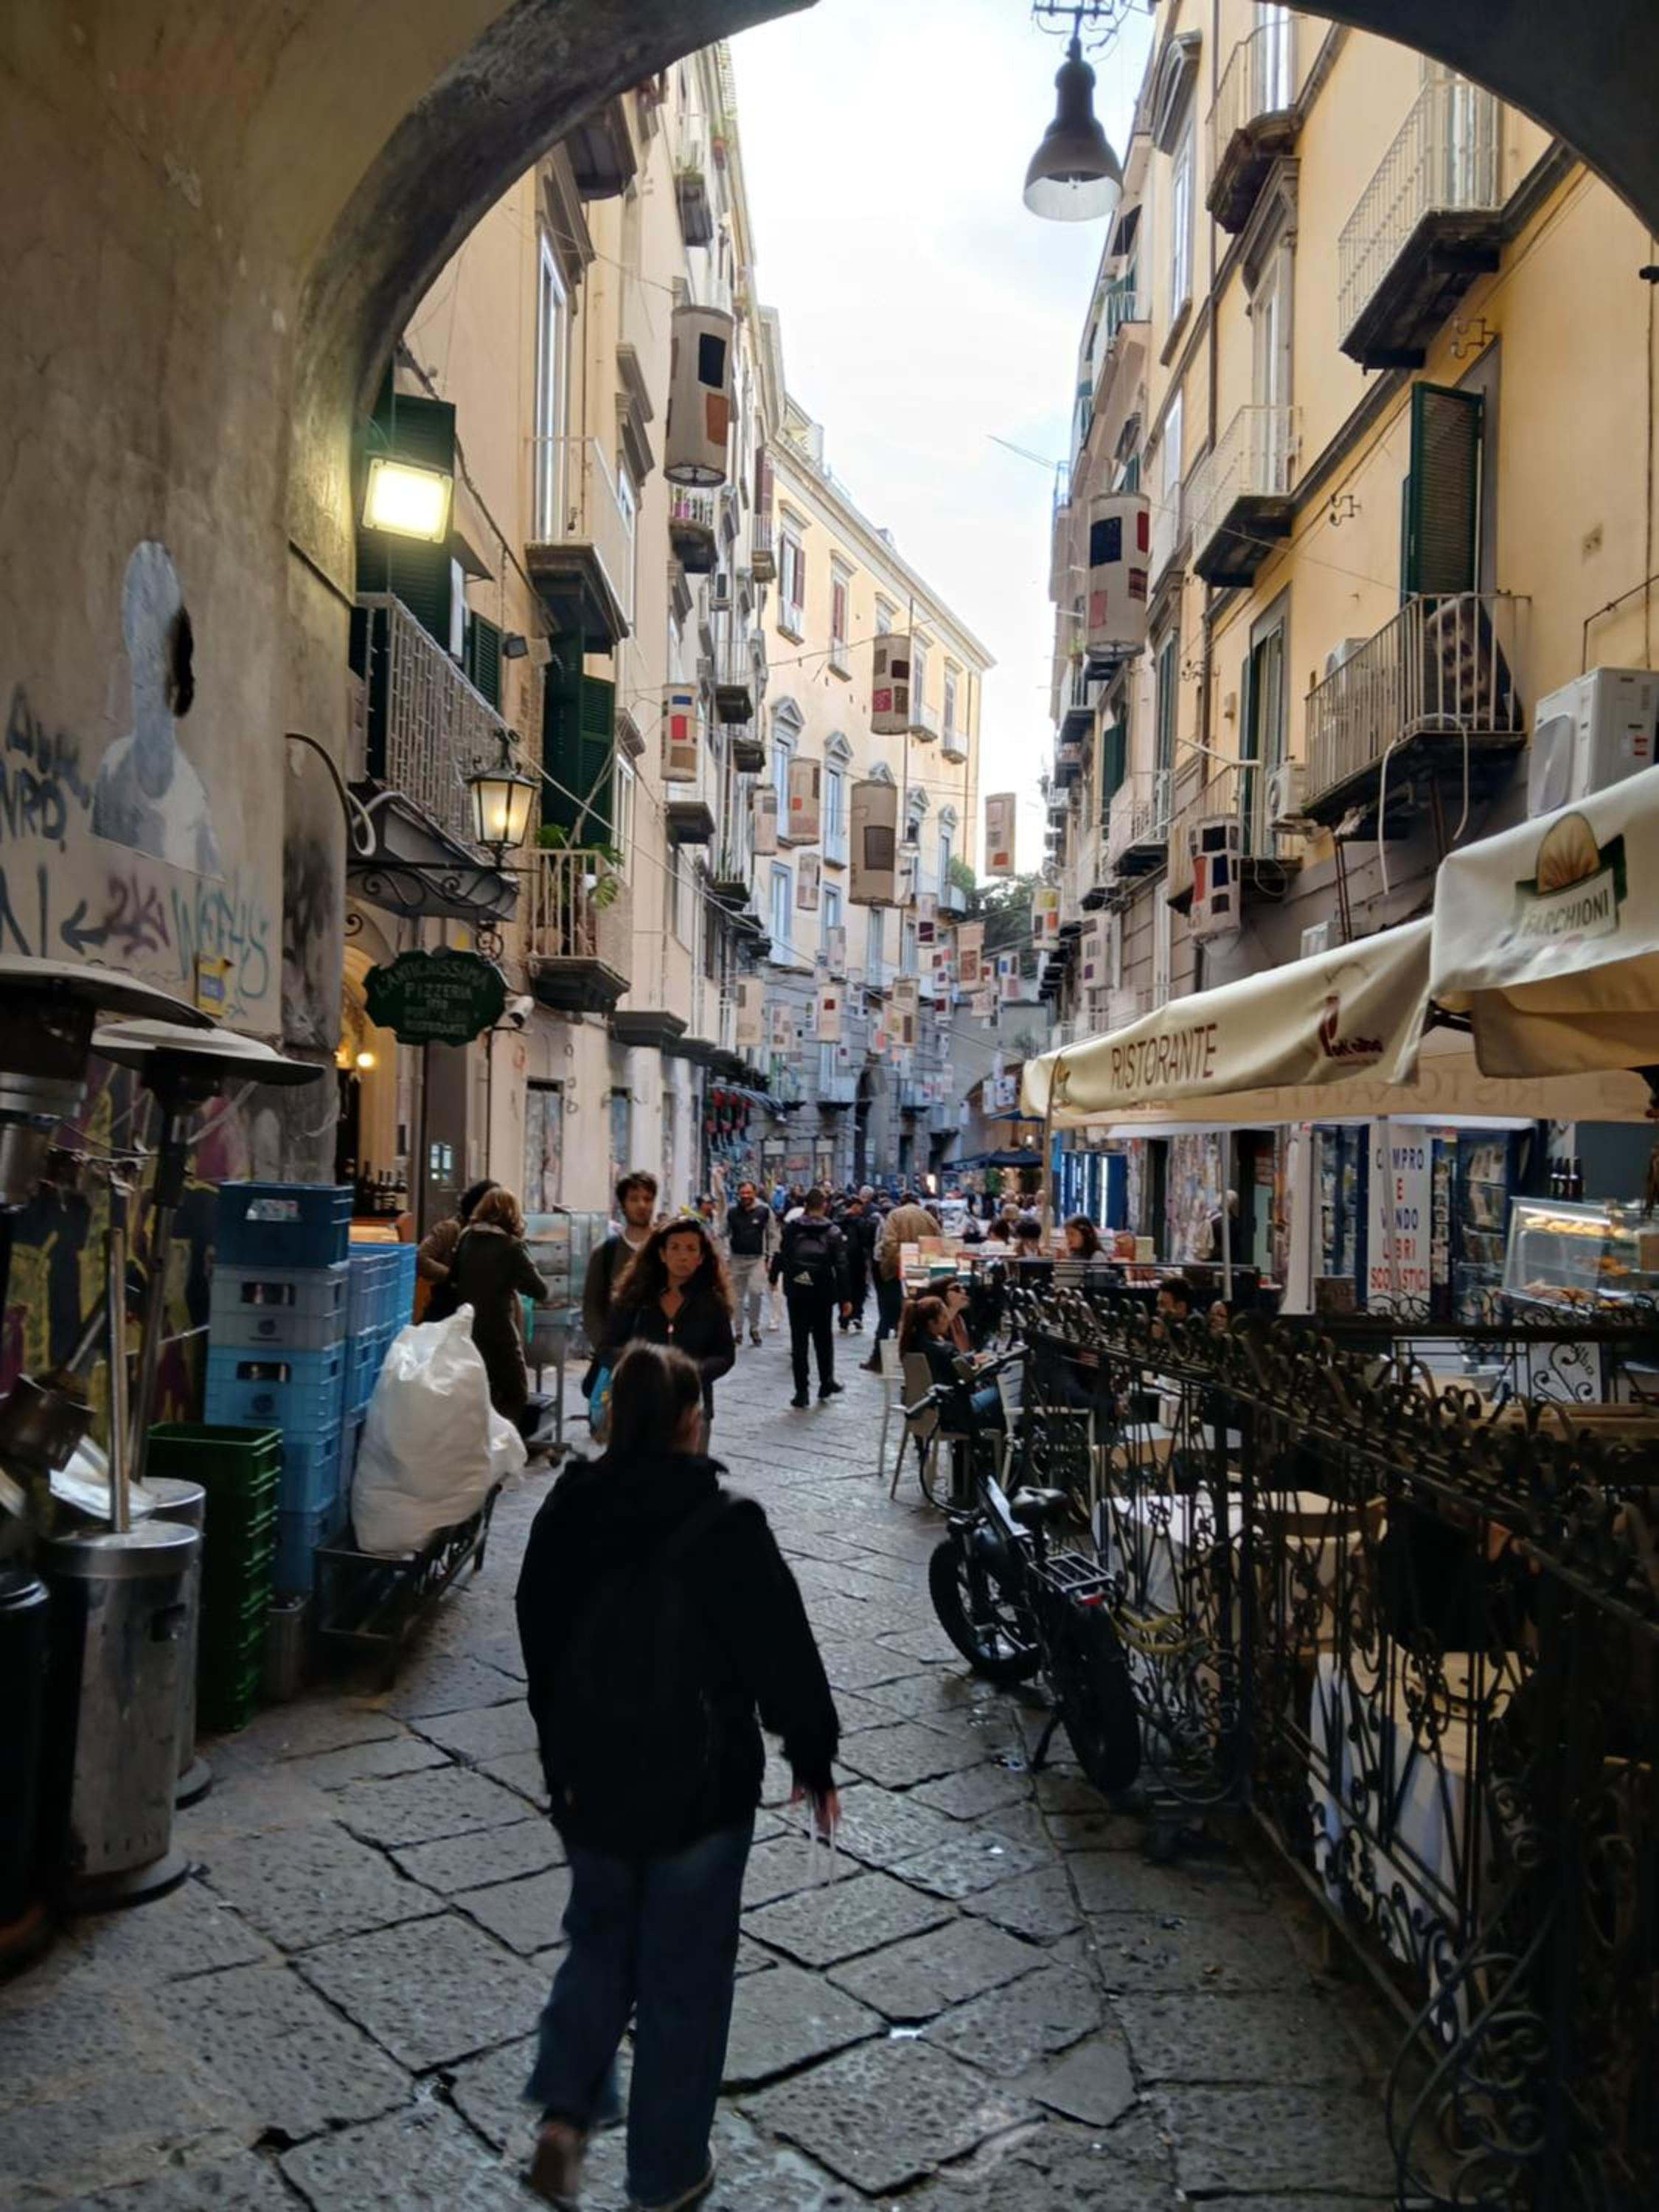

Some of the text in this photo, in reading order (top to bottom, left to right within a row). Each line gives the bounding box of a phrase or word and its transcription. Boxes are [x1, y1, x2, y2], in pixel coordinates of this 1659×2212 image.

[1110, 1022, 1217, 1090] RISTORANTE
[1376, 1148, 1425, 1170] CMPRO
[1396, 1178, 1405, 1201] E
[1380, 1207, 1419, 1230] VNDO
[1382, 1238, 1416, 1261] LBRI
[1370, 1267, 1428, 1292] SCOSTICI
